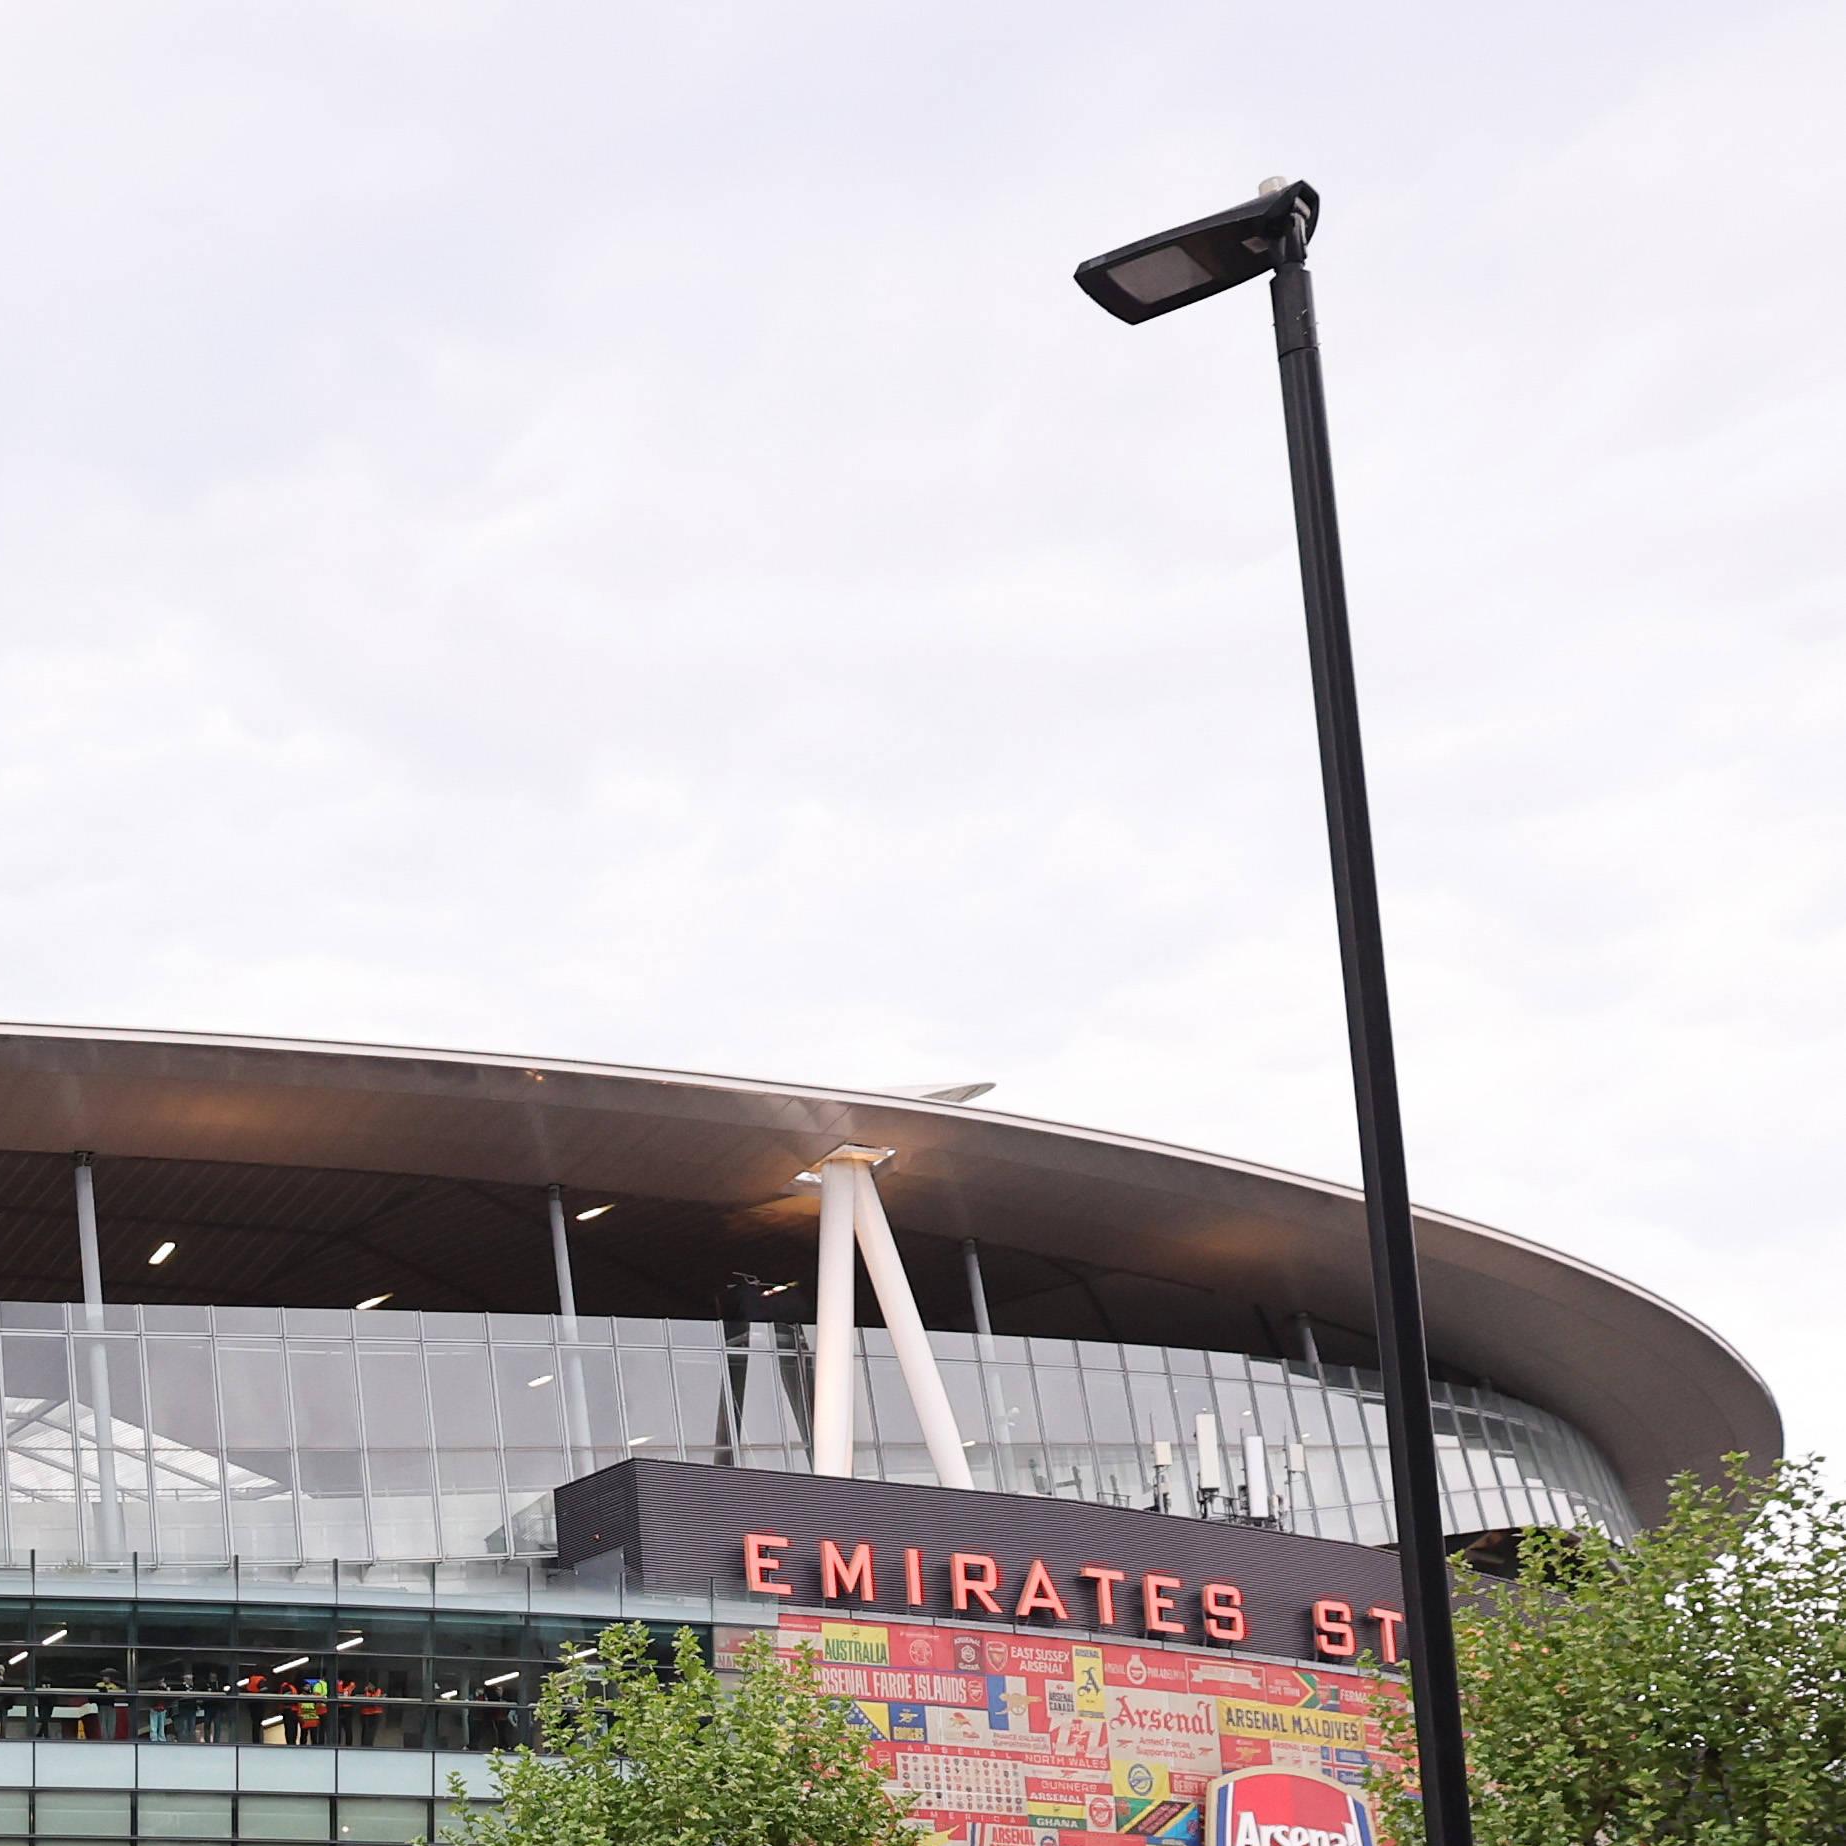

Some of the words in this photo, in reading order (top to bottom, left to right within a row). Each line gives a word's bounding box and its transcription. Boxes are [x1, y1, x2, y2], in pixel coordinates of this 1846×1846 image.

[743, 1531, 1246, 1643] EMIRATES
[824, 1636, 890, 1665] AUSTRALIA
[1010, 1646, 1035, 1660] EAST
[1035, 1648, 1070, 1663] SUSSEX
[1019, 1660, 1065, 1675] ARSENAL
[873, 1670, 914, 1700] FAROE
[914, 1673, 968, 1704] ISLANDS
[1109, 1694, 1216, 1737] Arsenal
[1226, 1707, 1288, 1733] ARSENAL
[1291, 1714, 1360, 1742] MALDIVES
[1024, 1754, 1066, 1767] NORTH
[1067, 1757, 1109, 1770] WALES
[1041, 1780, 1098, 1793] GUNNERS
[1029, 1792, 1083, 1804] ARSENAL
[1036, 1817, 1079, 1829] GHANA
[992, 1826, 1036, 1845] ARSENAL
